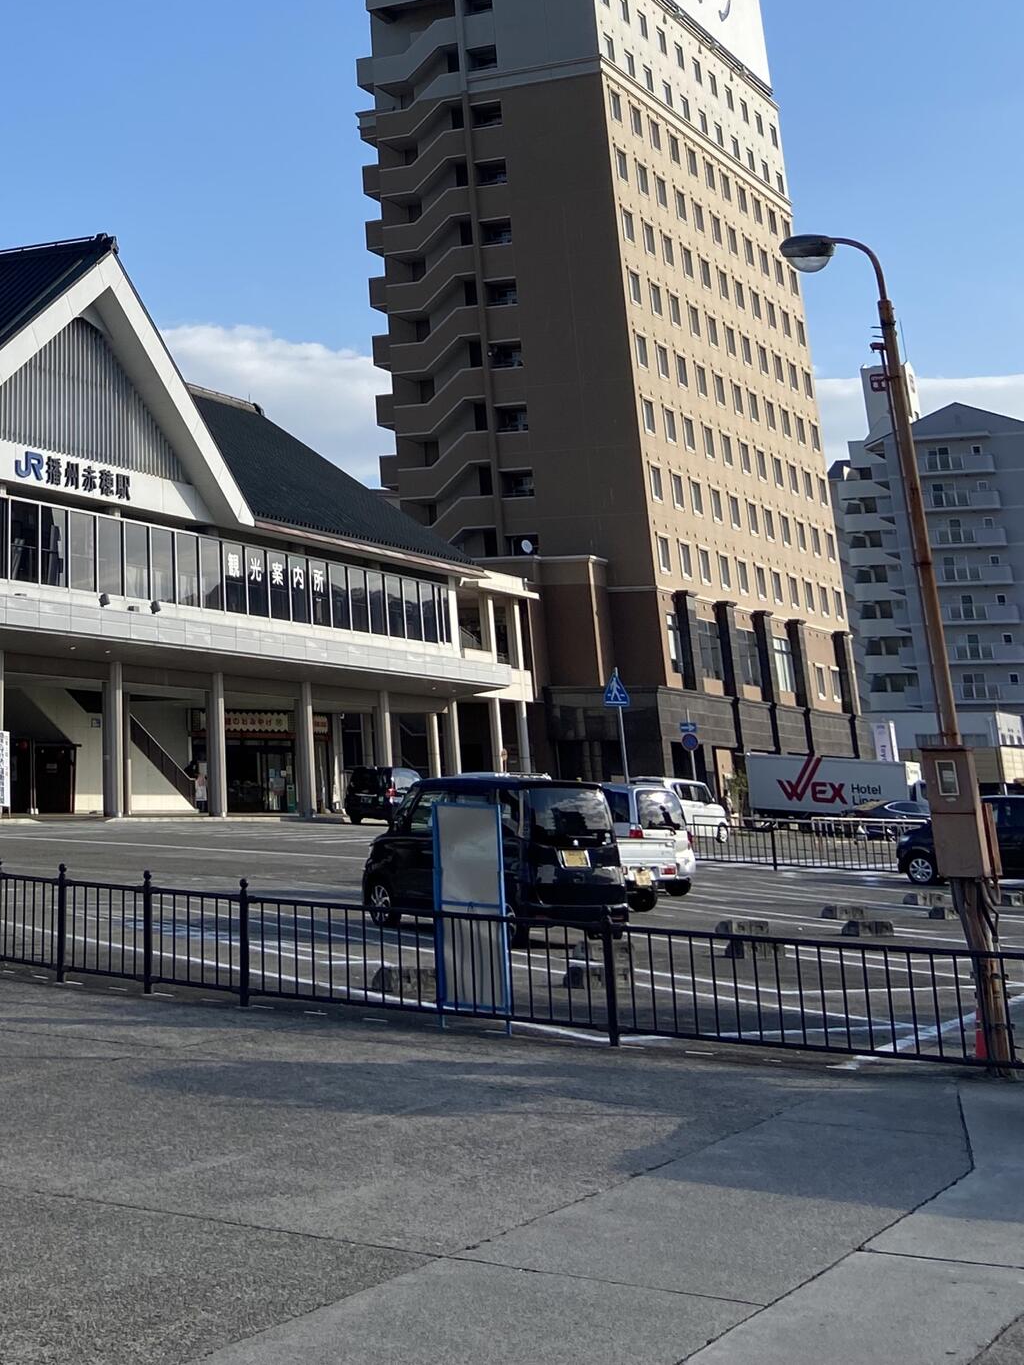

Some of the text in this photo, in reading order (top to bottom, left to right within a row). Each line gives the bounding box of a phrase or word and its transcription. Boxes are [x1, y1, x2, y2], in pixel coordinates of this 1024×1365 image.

[227, 552, 324, 594] 観光案内所
[776, 754, 849, 806] WEX
[851, 783, 882, 795] Hotel
